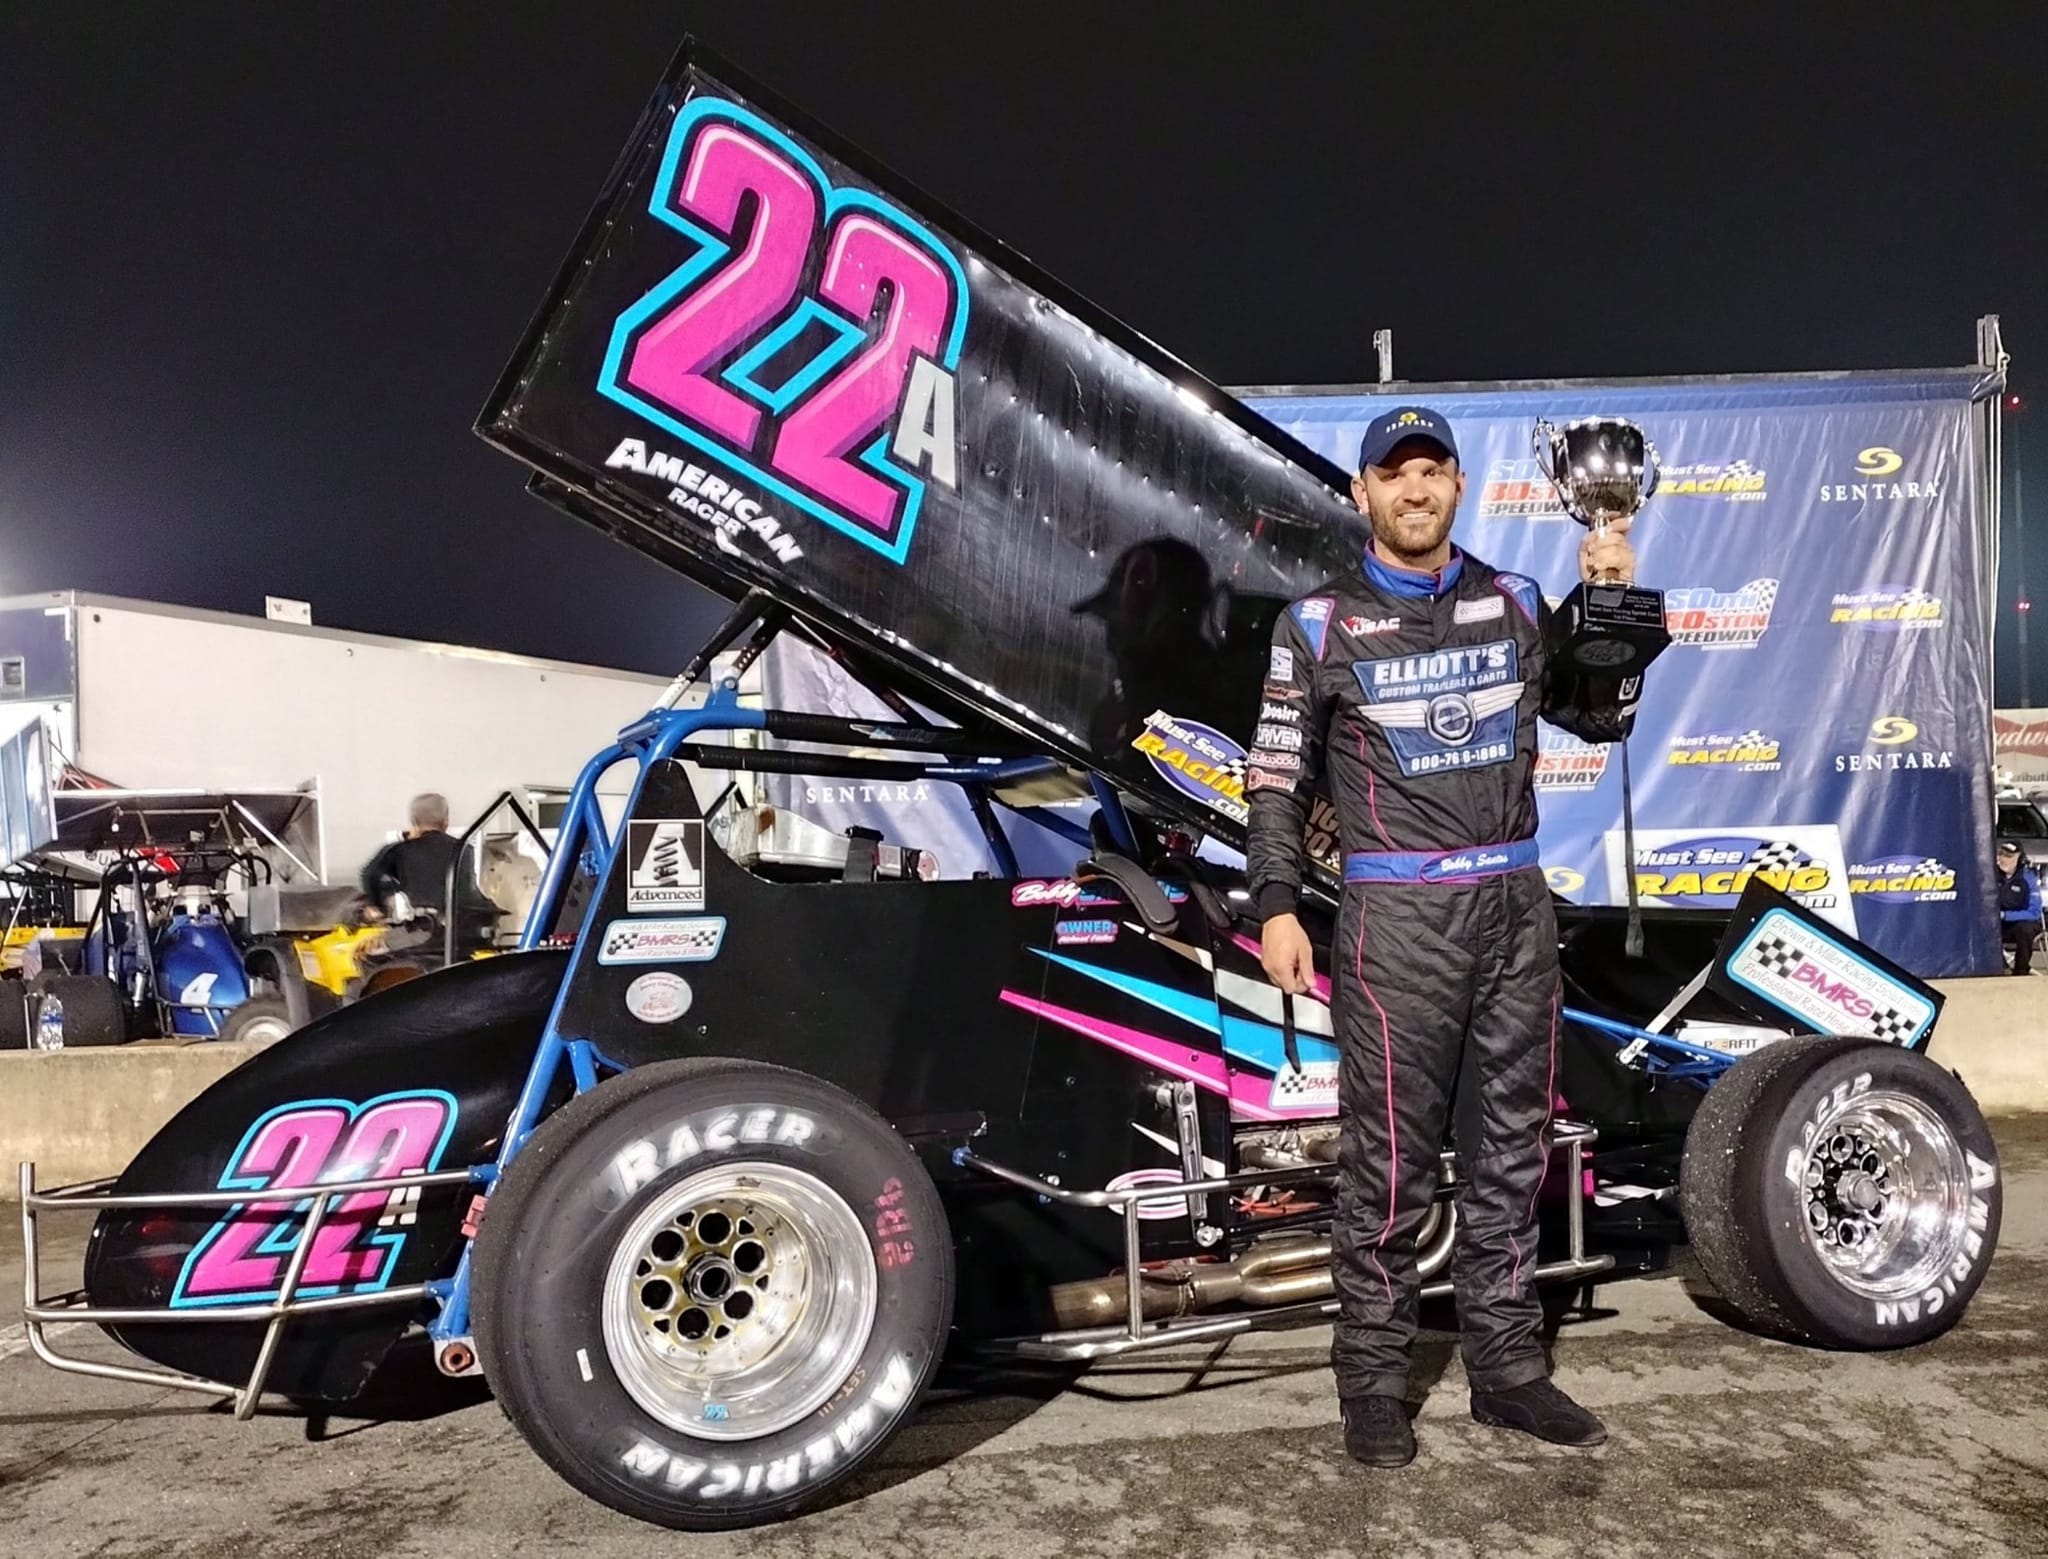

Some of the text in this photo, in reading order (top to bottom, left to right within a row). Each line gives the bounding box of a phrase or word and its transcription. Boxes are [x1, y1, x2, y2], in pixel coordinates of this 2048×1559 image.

[1657, 475, 1765, 494] RACING
[1820, 482, 1939, 502] SENTARA
[606, 437, 803, 564] AMERICAN
[668, 488, 742, 535] RACER
[1831, 602, 1942, 623] RACING
[1352, 617, 1400, 636] USAC
[1671, 629, 1762, 644] PEEDWAY
[1374, 645, 1507, 685] ELLIOTT'S
[1378, 683, 1421, 699] CUSTOM
[1422, 678, 1466, 695] TRAILERS
[1477, 670, 1508, 685] CARTS
[1147, 711, 1228, 762] Must See
[1669, 734, 1734, 747] Must See
[1668, 745, 1780, 765] RACING
[1835, 751, 1953, 772] SENTARA
[1134, 731, 1250, 806] RACIN
[1737, 760, 1782, 773] .com
[805, 783, 930, 804] SENTARA
[1633, 847, 1745, 867] Must See
[1848, 863, 1911, 876] Must See
[1627, 864, 1833, 898] RACING
[1849, 873, 1956, 893] RACING
[630, 888, 703, 903] Advanced
[1016, 882, 1081, 904] Bobby
[1914, 890, 1958, 902] .com
[636, 933, 692, 948] BMRS
[1772, 917, 1807, 943] Brown
[1815, 943, 1844, 967] Miller
[1841, 957, 1880, 990] Racing
[180, 973, 218, 1013] 4
[1792, 961, 1875, 1018] BMRS
[1800, 995, 1826, 1017] Race
[614, 1109, 816, 1199] RACER
[1876, 1149, 1995, 1326] AMERICAN
[620, 1350, 914, 1499] AMERICAN
